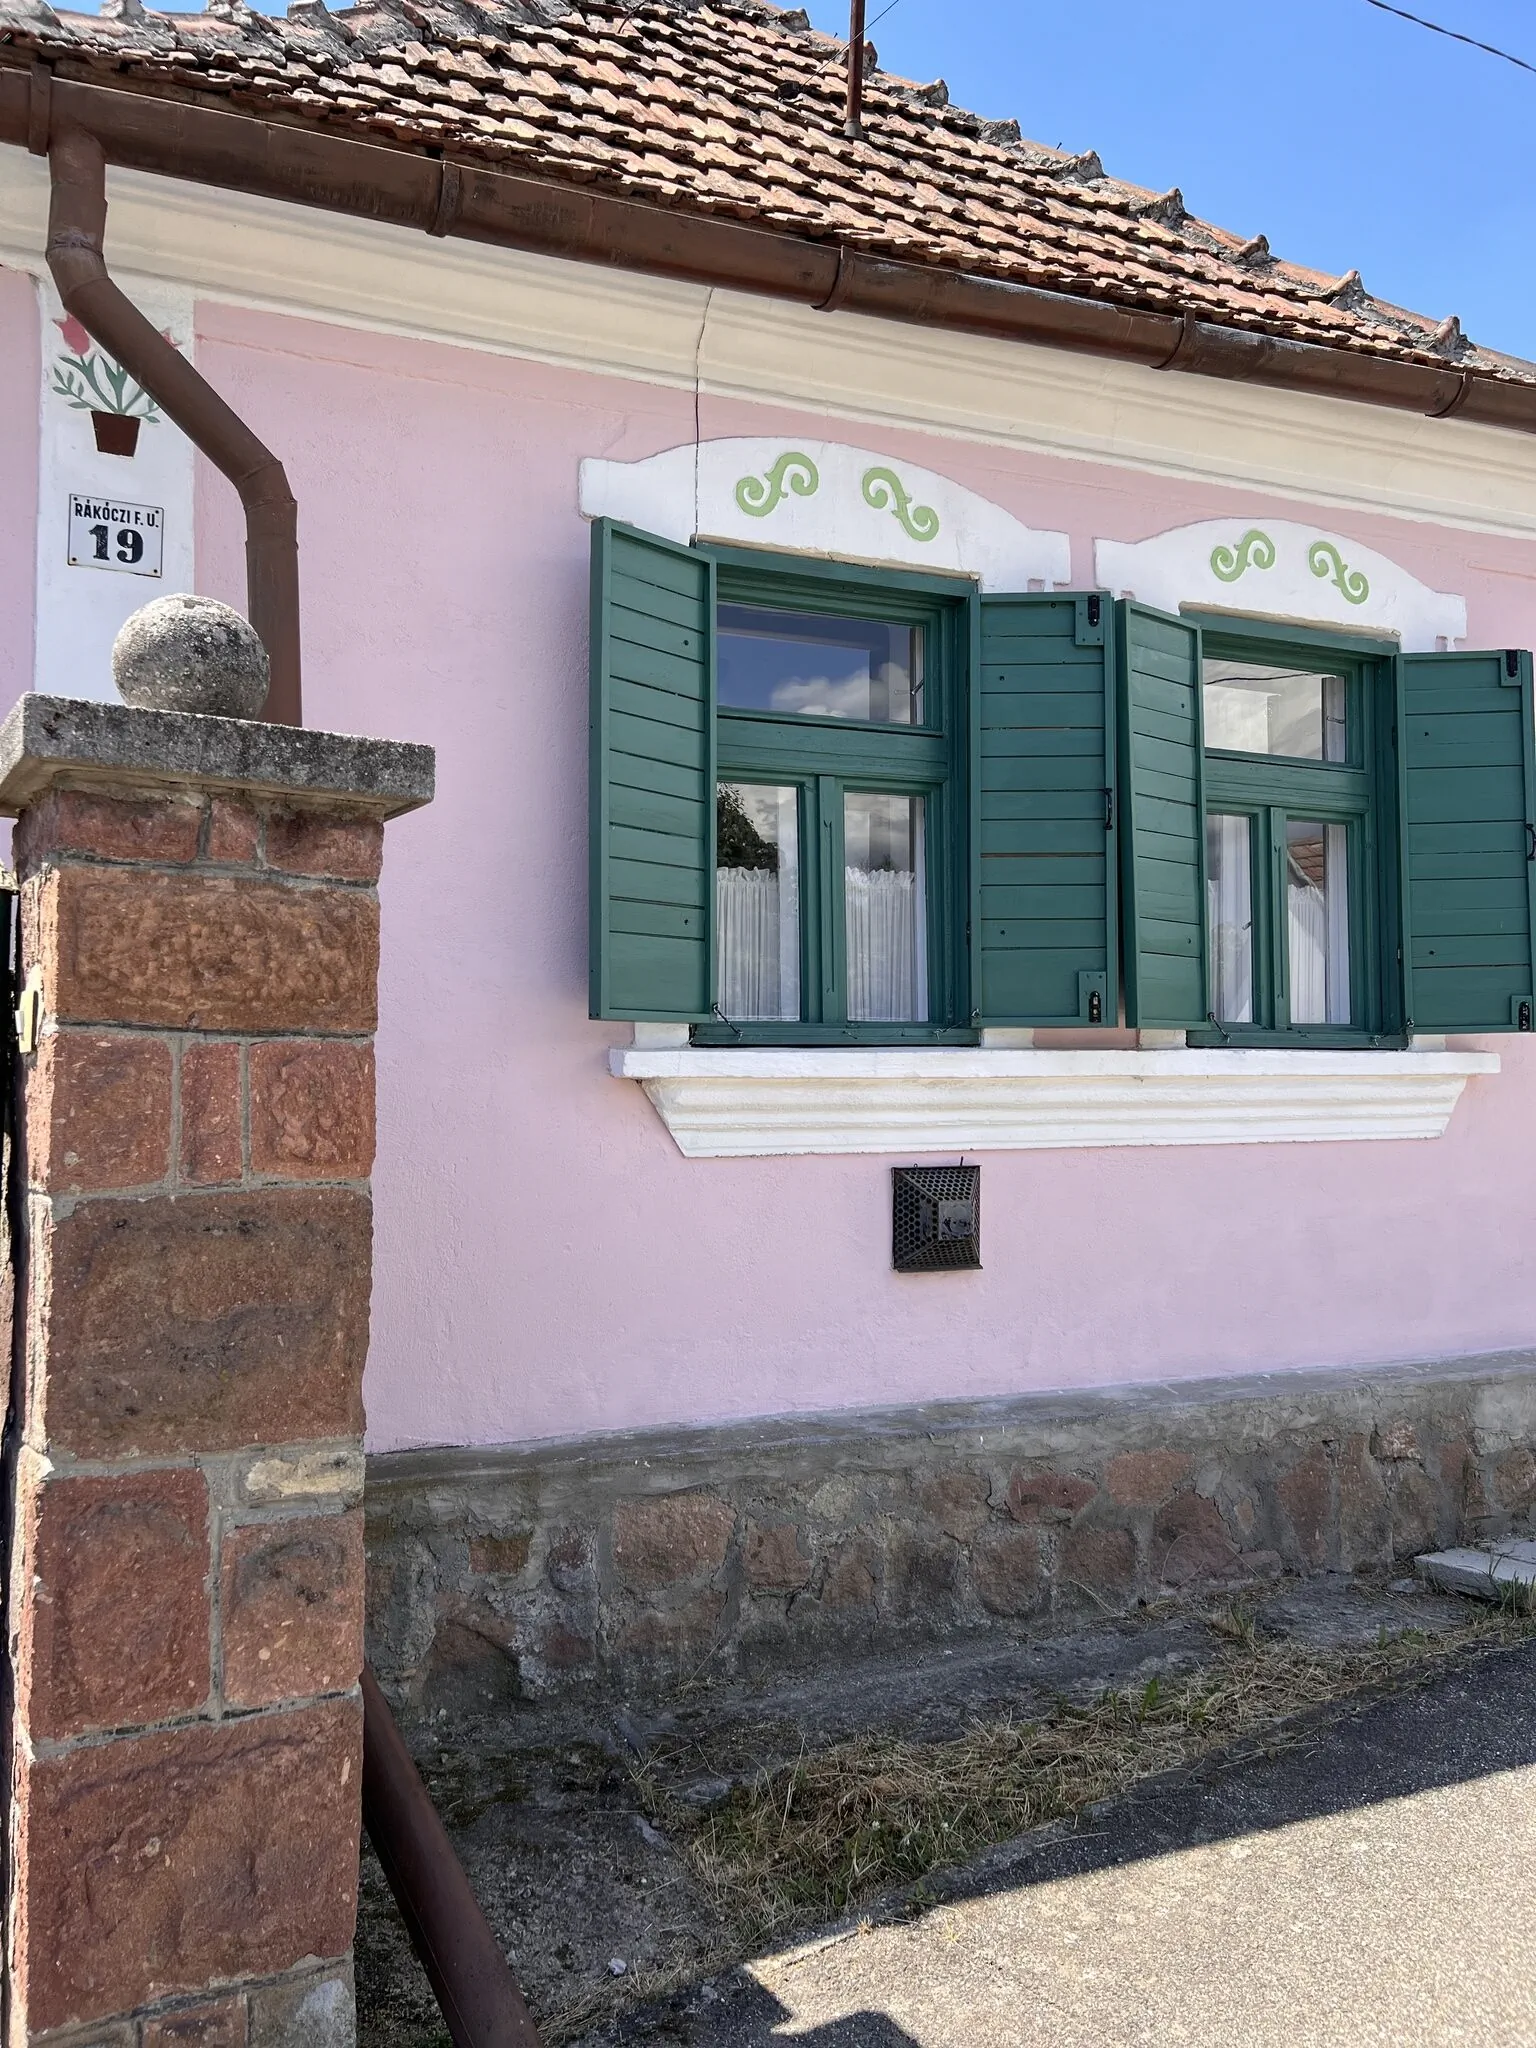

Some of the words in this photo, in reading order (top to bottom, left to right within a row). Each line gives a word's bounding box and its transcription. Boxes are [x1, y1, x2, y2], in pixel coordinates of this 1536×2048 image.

[75, 499, 130, 524] RÁKÓCZI
[134, 511, 144, 526] F.
[147, 513, 159, 528] U.
[88, 524, 144, 564] 19
